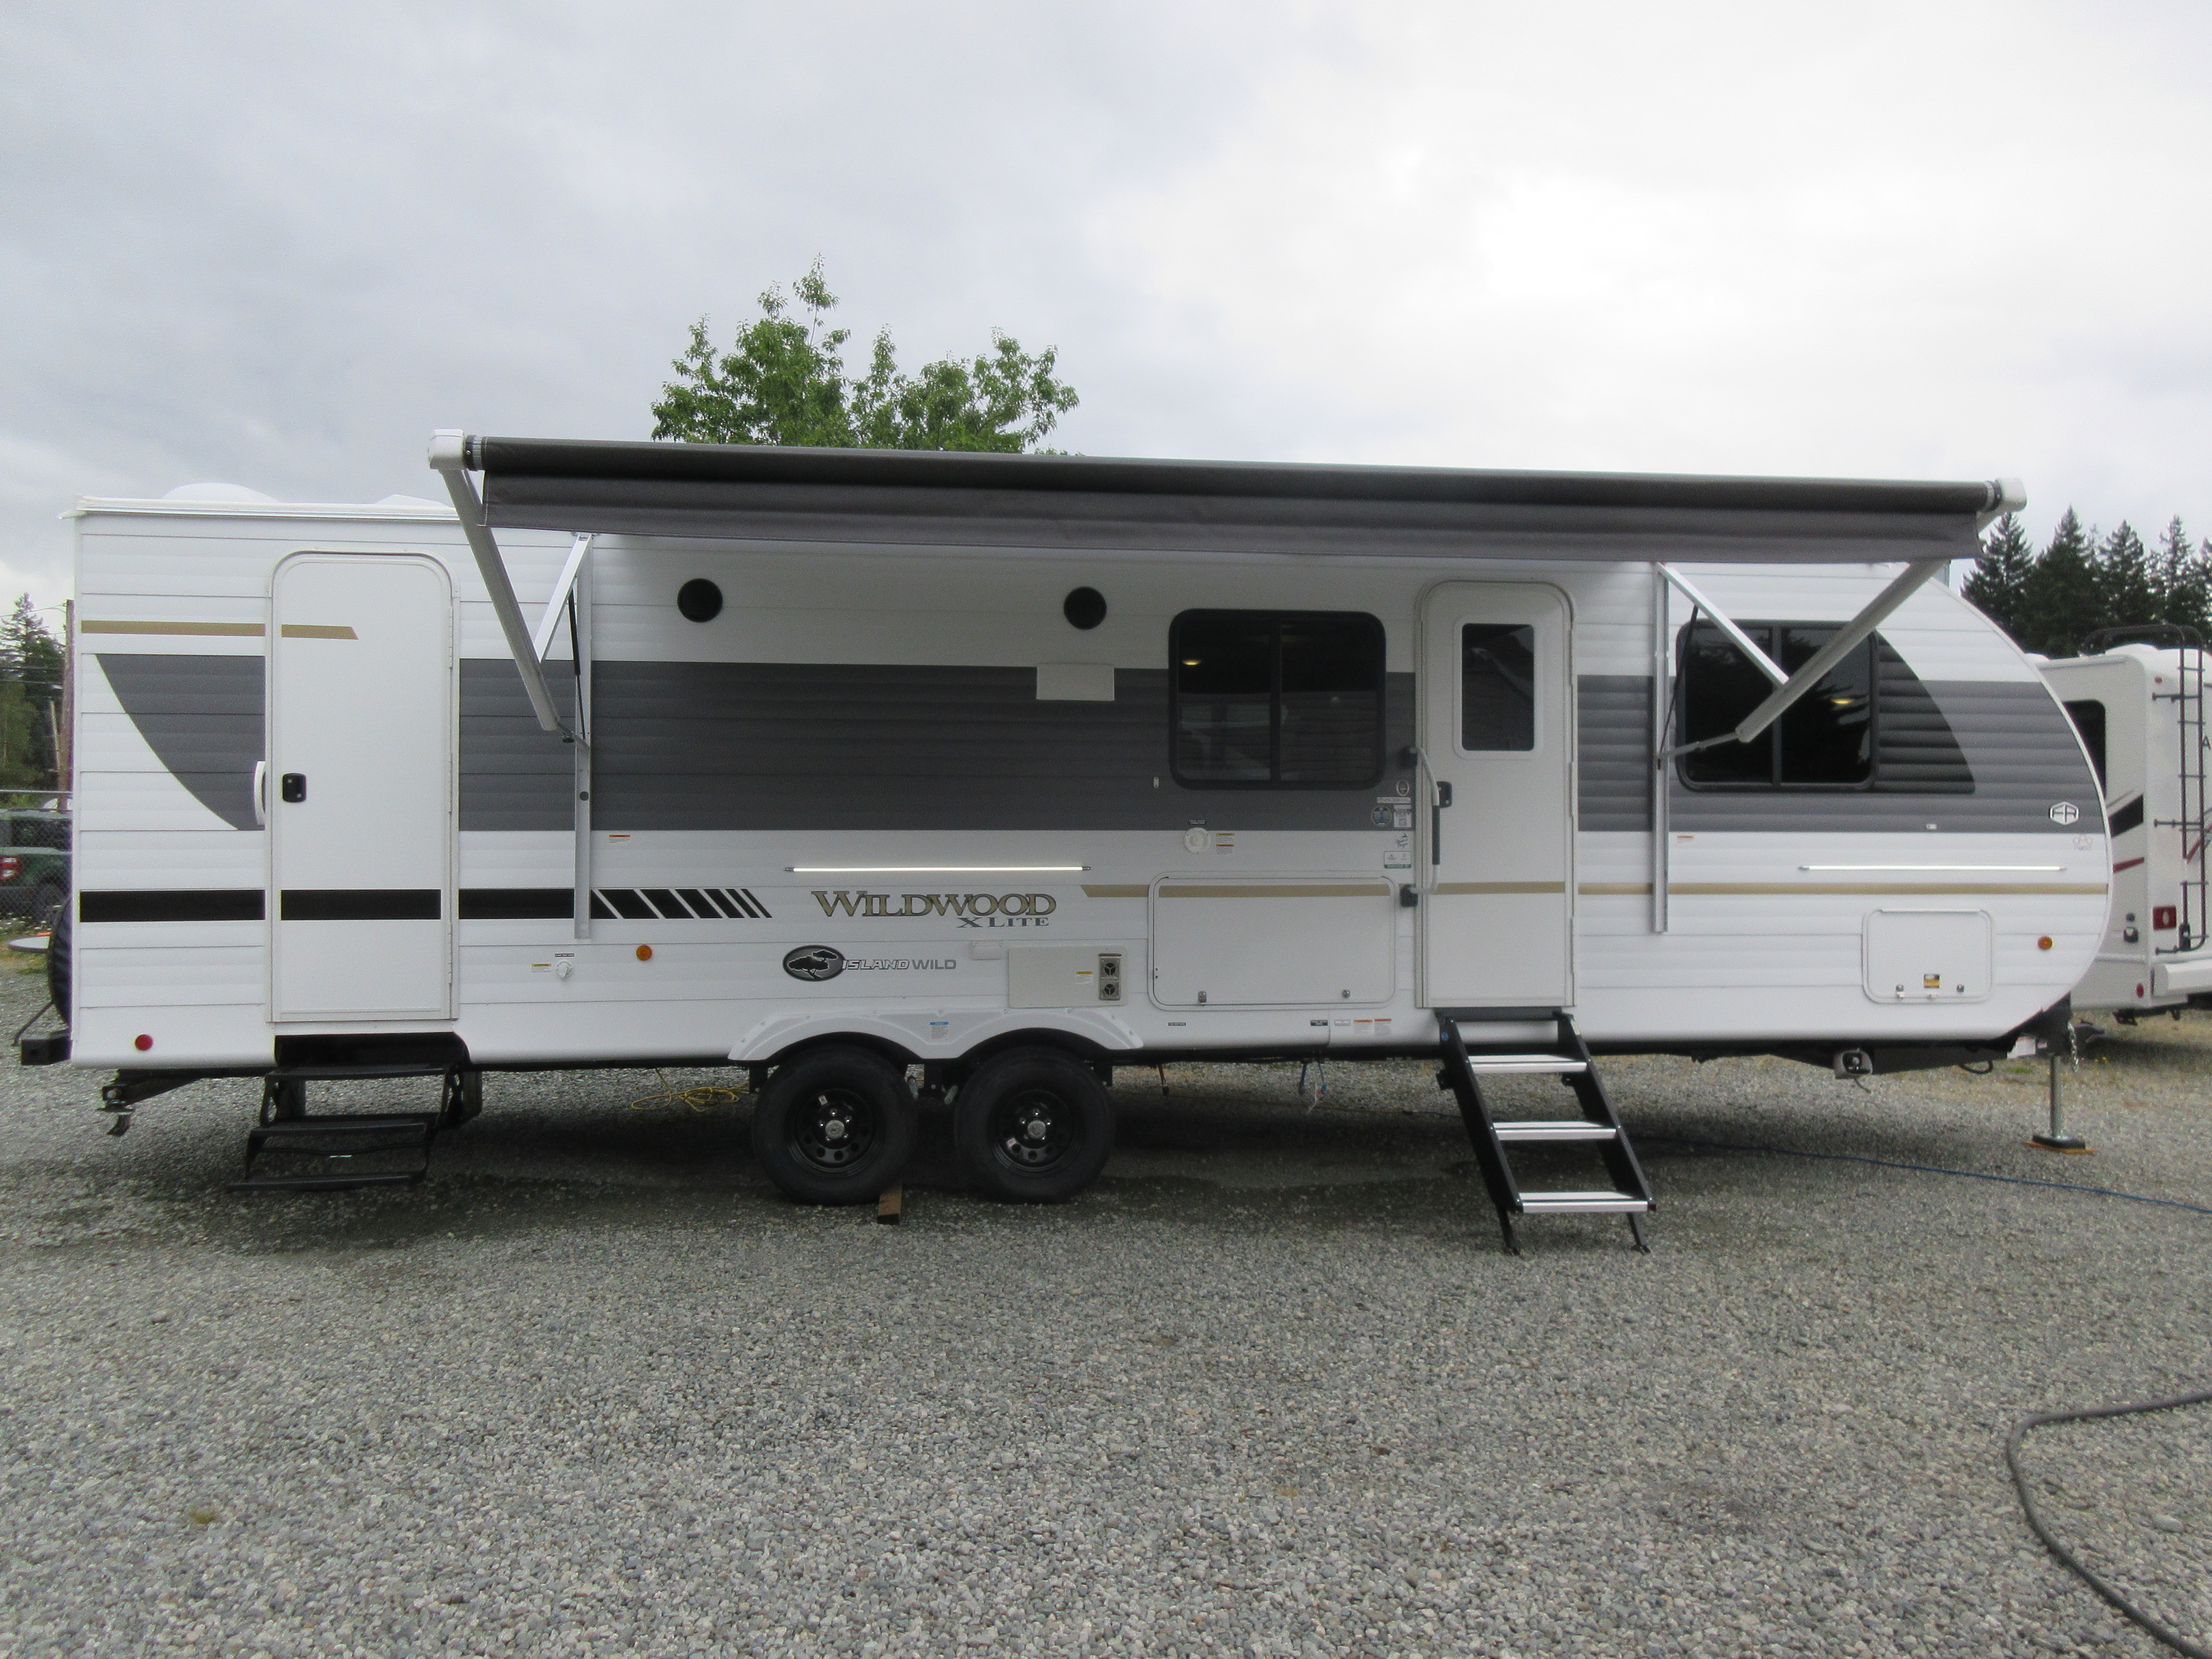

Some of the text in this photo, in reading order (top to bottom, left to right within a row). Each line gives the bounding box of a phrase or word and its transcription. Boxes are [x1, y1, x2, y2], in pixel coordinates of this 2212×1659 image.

[811, 891, 1057, 917] WILDWOOD
[842, 959, 957, 970] ISLAND WILD
